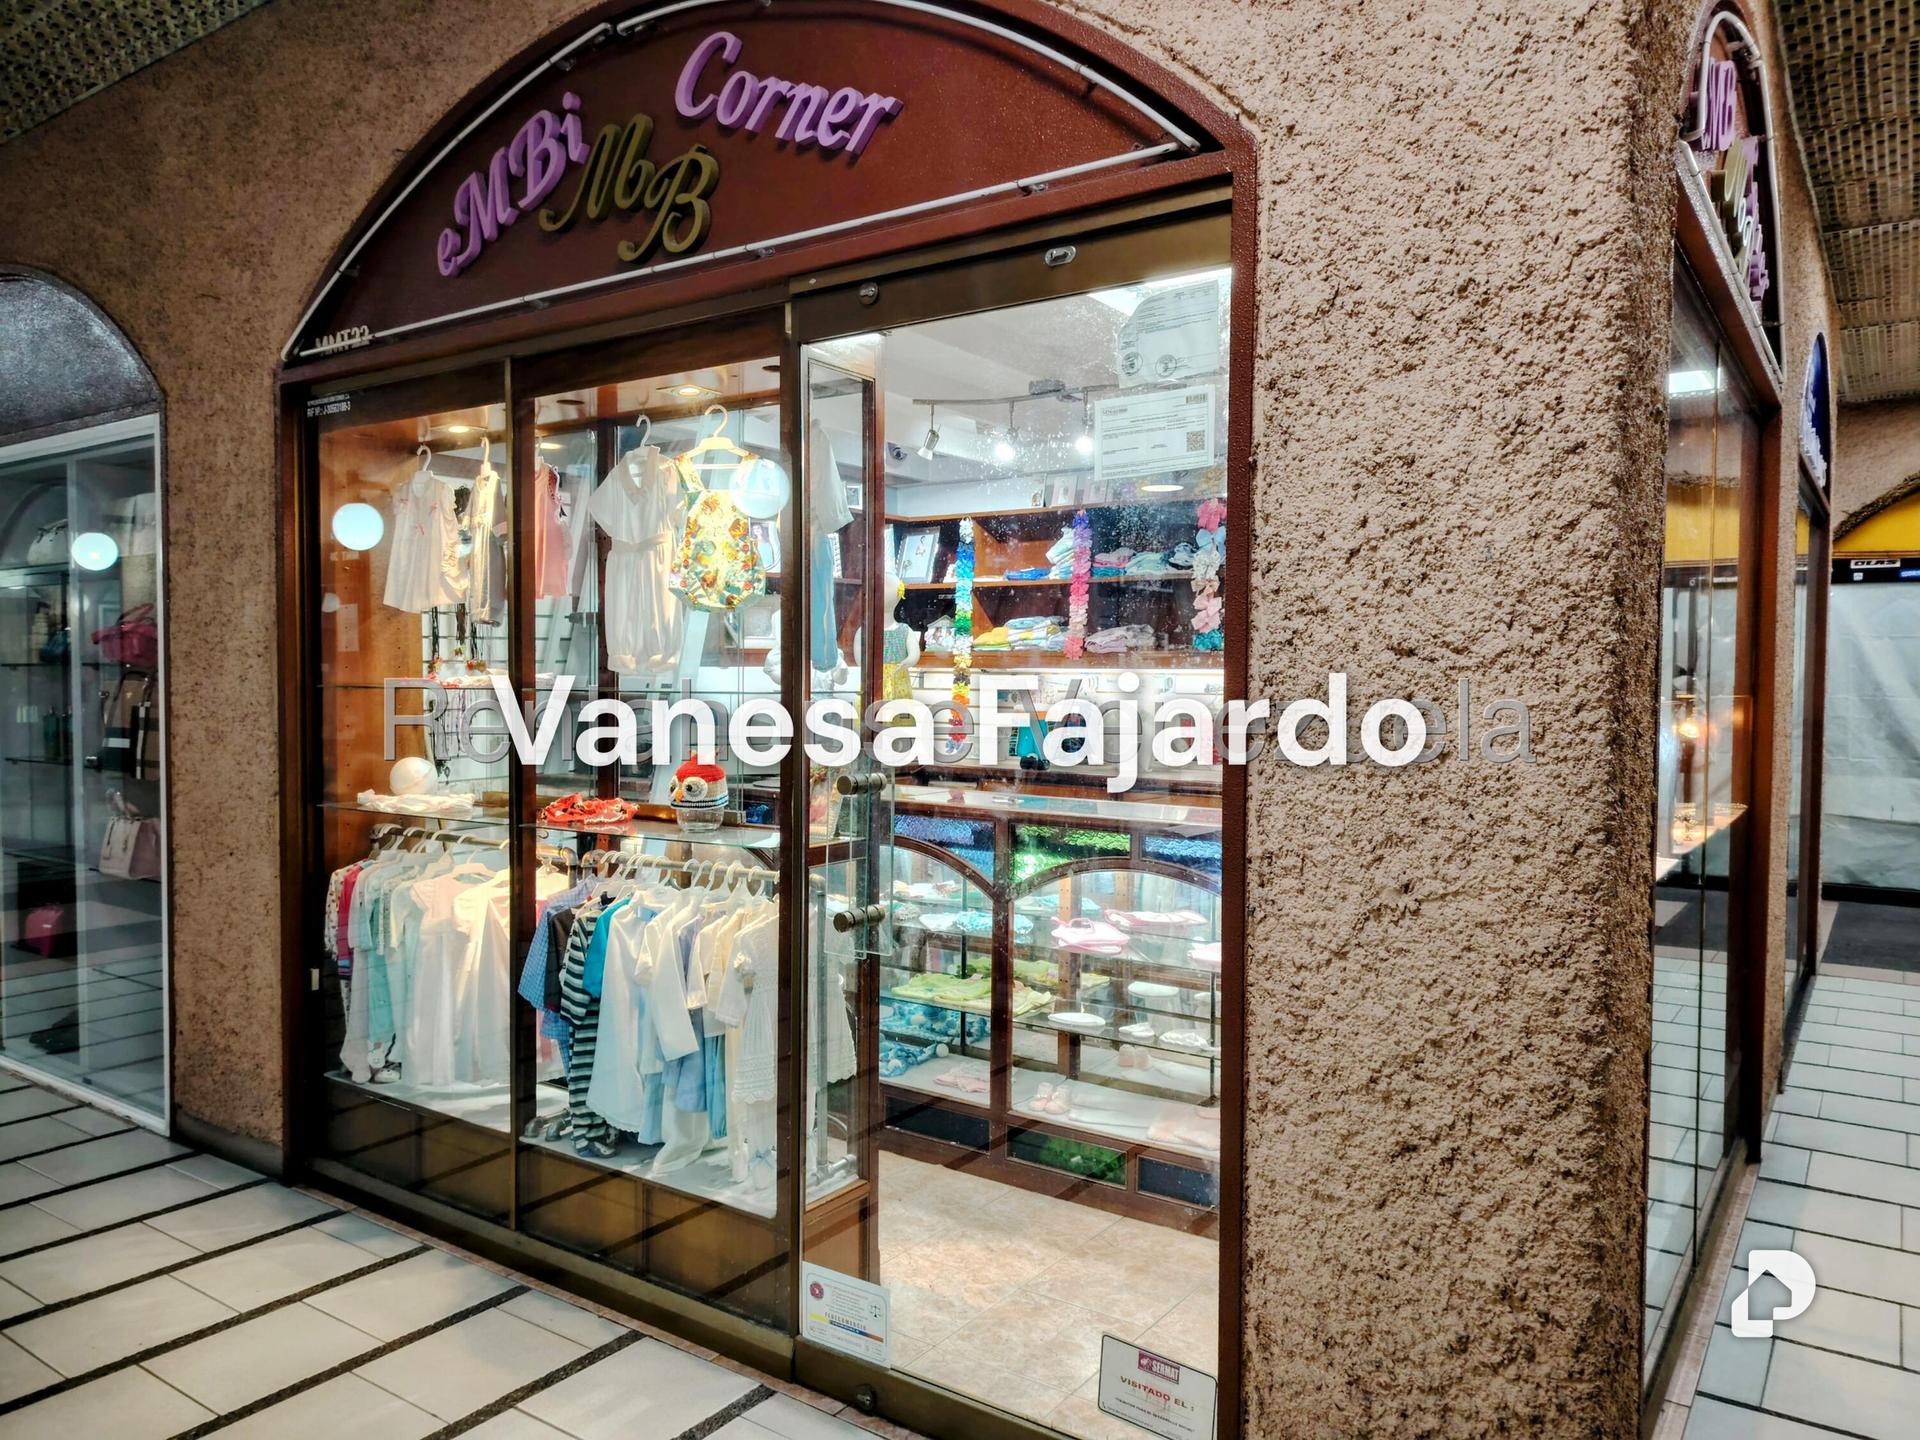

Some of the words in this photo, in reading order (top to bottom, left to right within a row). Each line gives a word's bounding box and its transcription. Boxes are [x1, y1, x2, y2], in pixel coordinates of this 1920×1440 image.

[437, 91, 590, 277] eMBi
[675, 30, 904, 156] Corner
[1120, 1375, 1171, 1401] VISITADO
